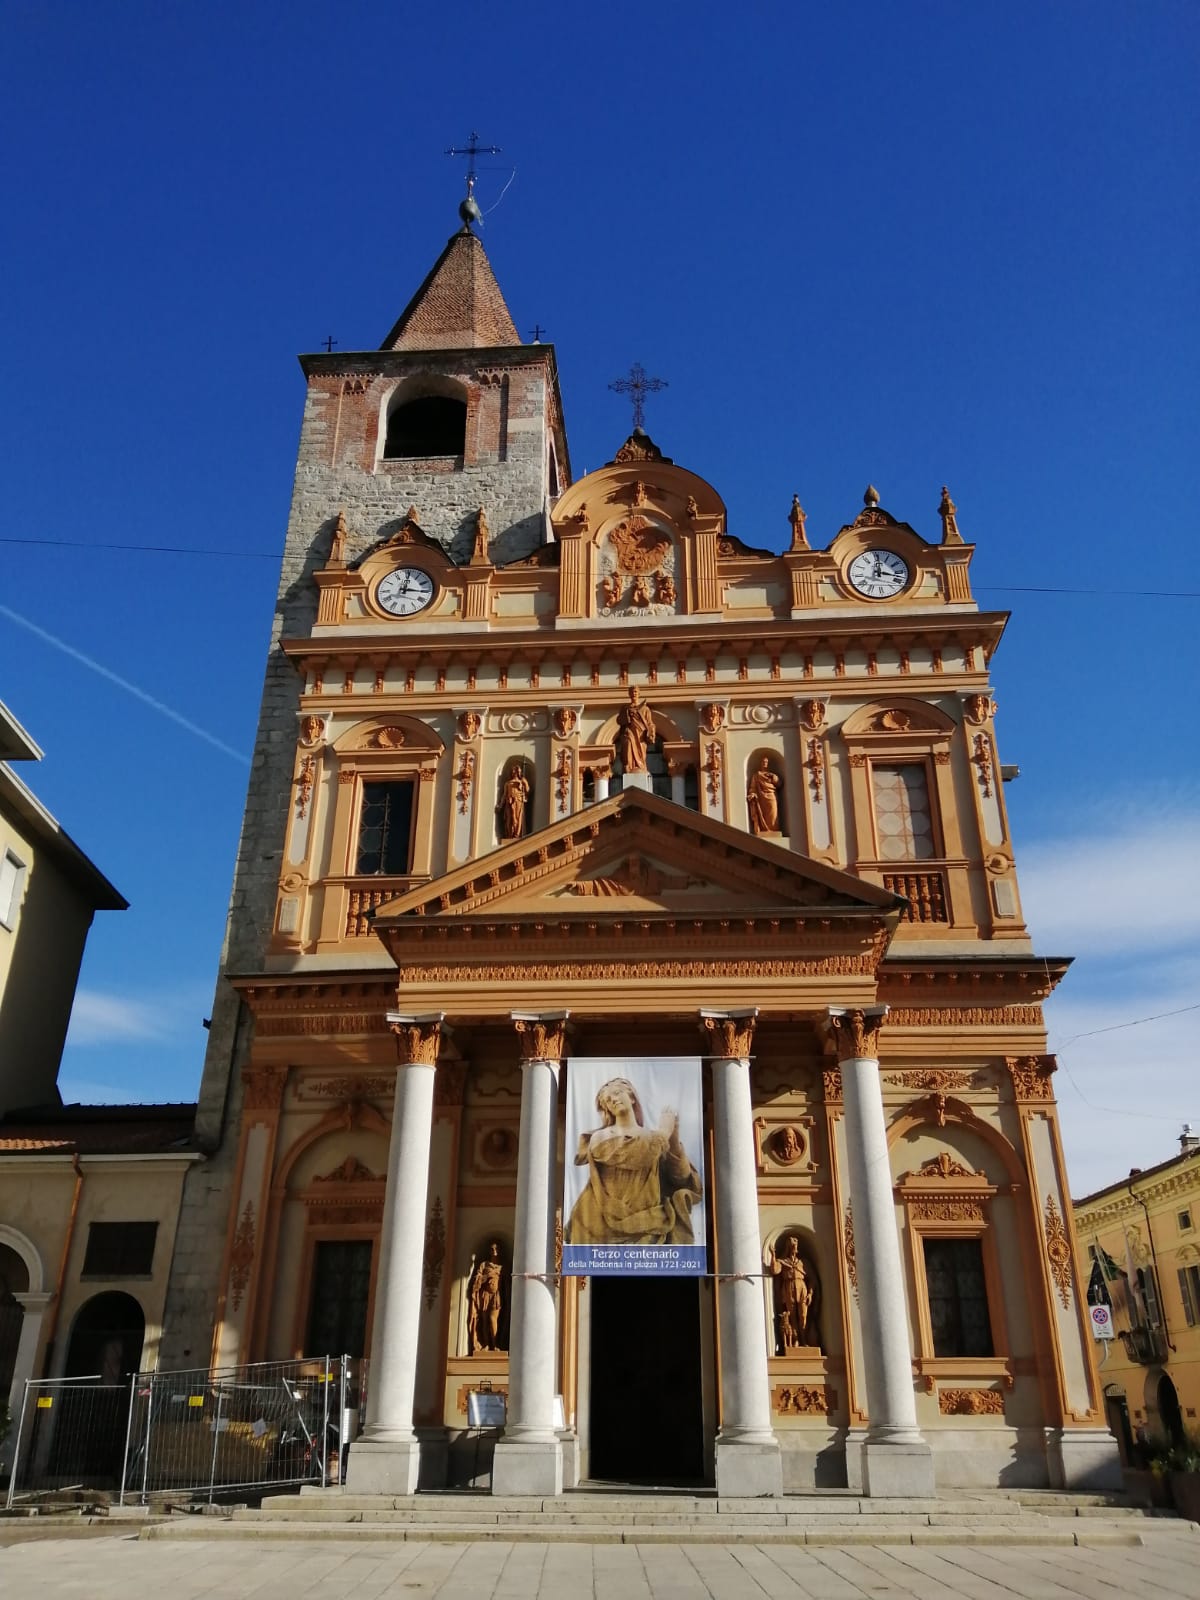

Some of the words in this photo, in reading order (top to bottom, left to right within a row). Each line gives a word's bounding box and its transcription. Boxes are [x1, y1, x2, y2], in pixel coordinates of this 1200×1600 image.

[591, 1248, 620, 1259] Terzo
[623, 1248, 680, 1259] centenario
[568, 1260, 587, 1268] della
[588, 1260, 623, 1268] Madonna
[624, 1260, 632, 1268] in
[634, 1260, 658, 1270] piazza
[660, 1260, 701, 1269] 1721-2021
